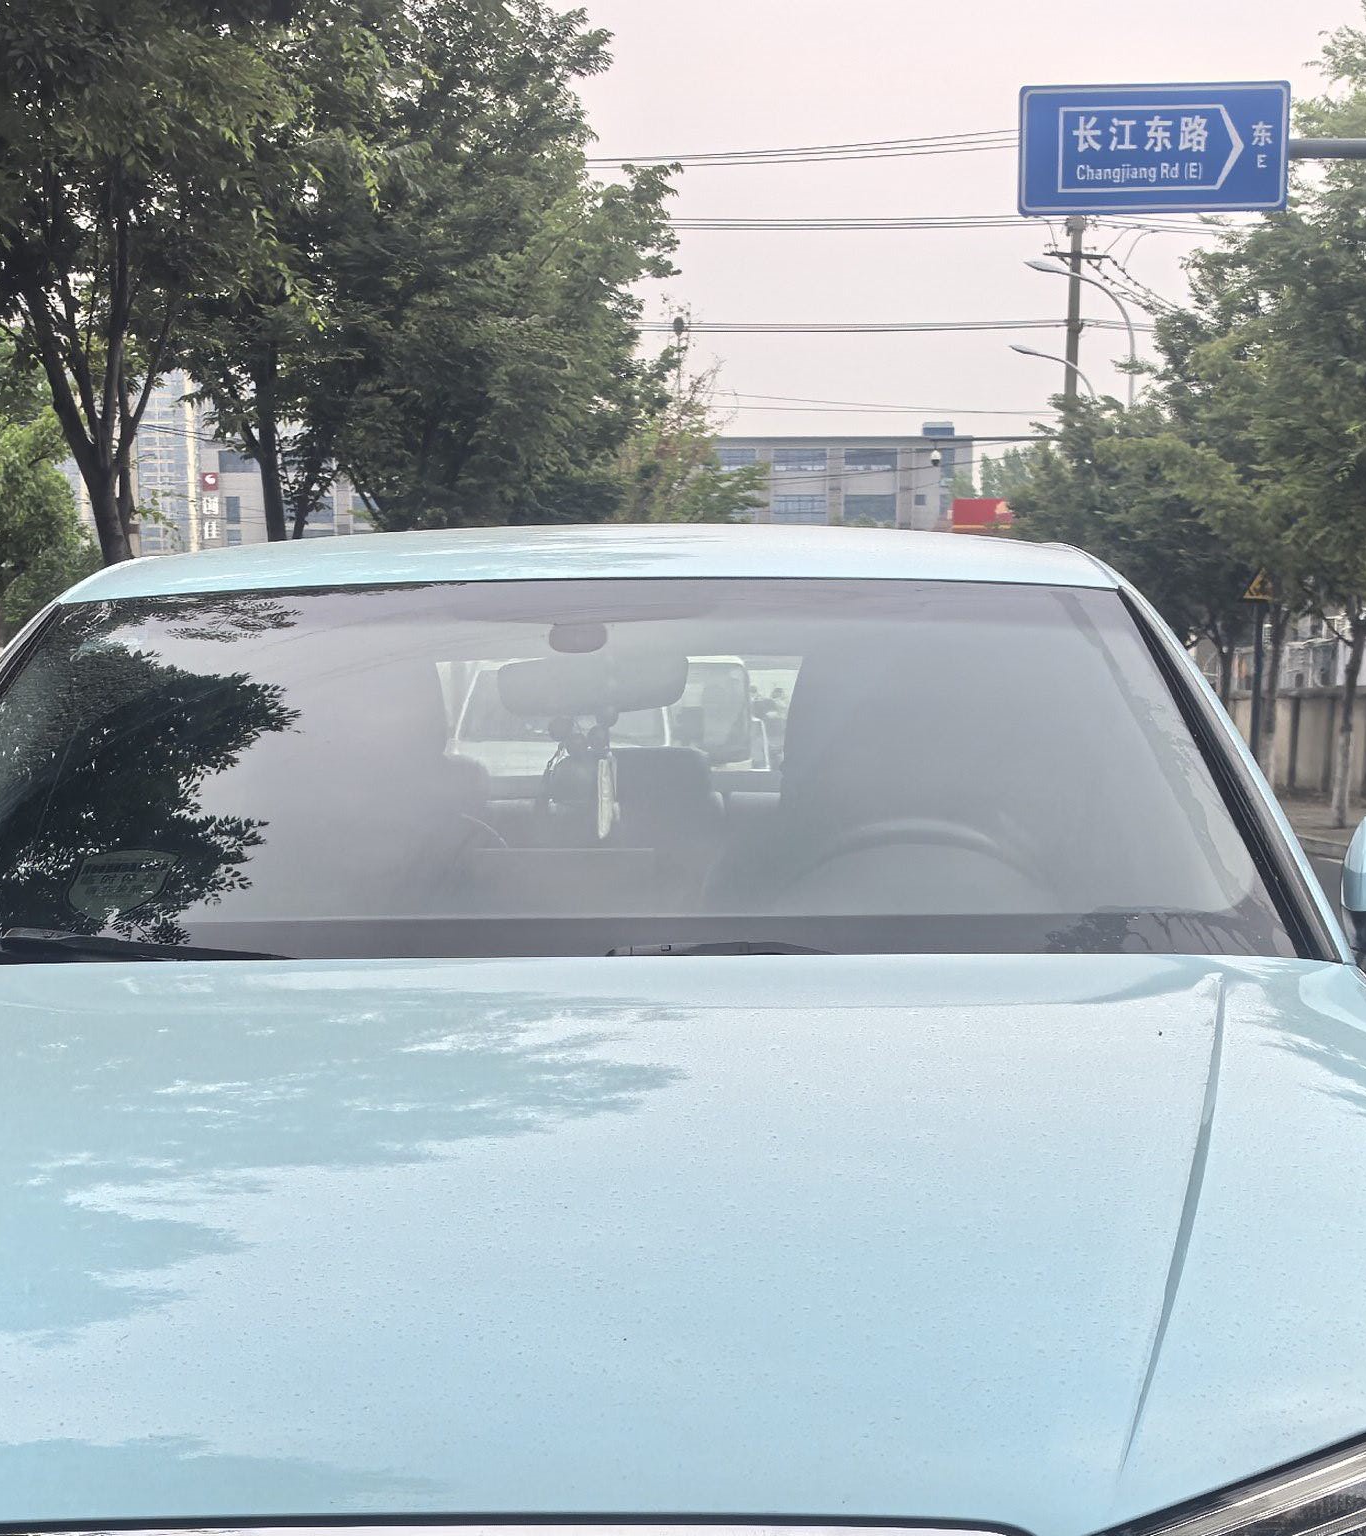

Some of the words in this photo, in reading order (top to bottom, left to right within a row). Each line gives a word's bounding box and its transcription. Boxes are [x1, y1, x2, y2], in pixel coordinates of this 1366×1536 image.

[1072, 115, 1209, 153] 长江东路
[1250, 121, 1274, 147] 东
[1076, 163, 1157, 183] Changjiang
[1160, 162, 1180, 179] Rd
[1184, 161, 1204, 180] (E)
[1256, 154, 1268, 169] E
